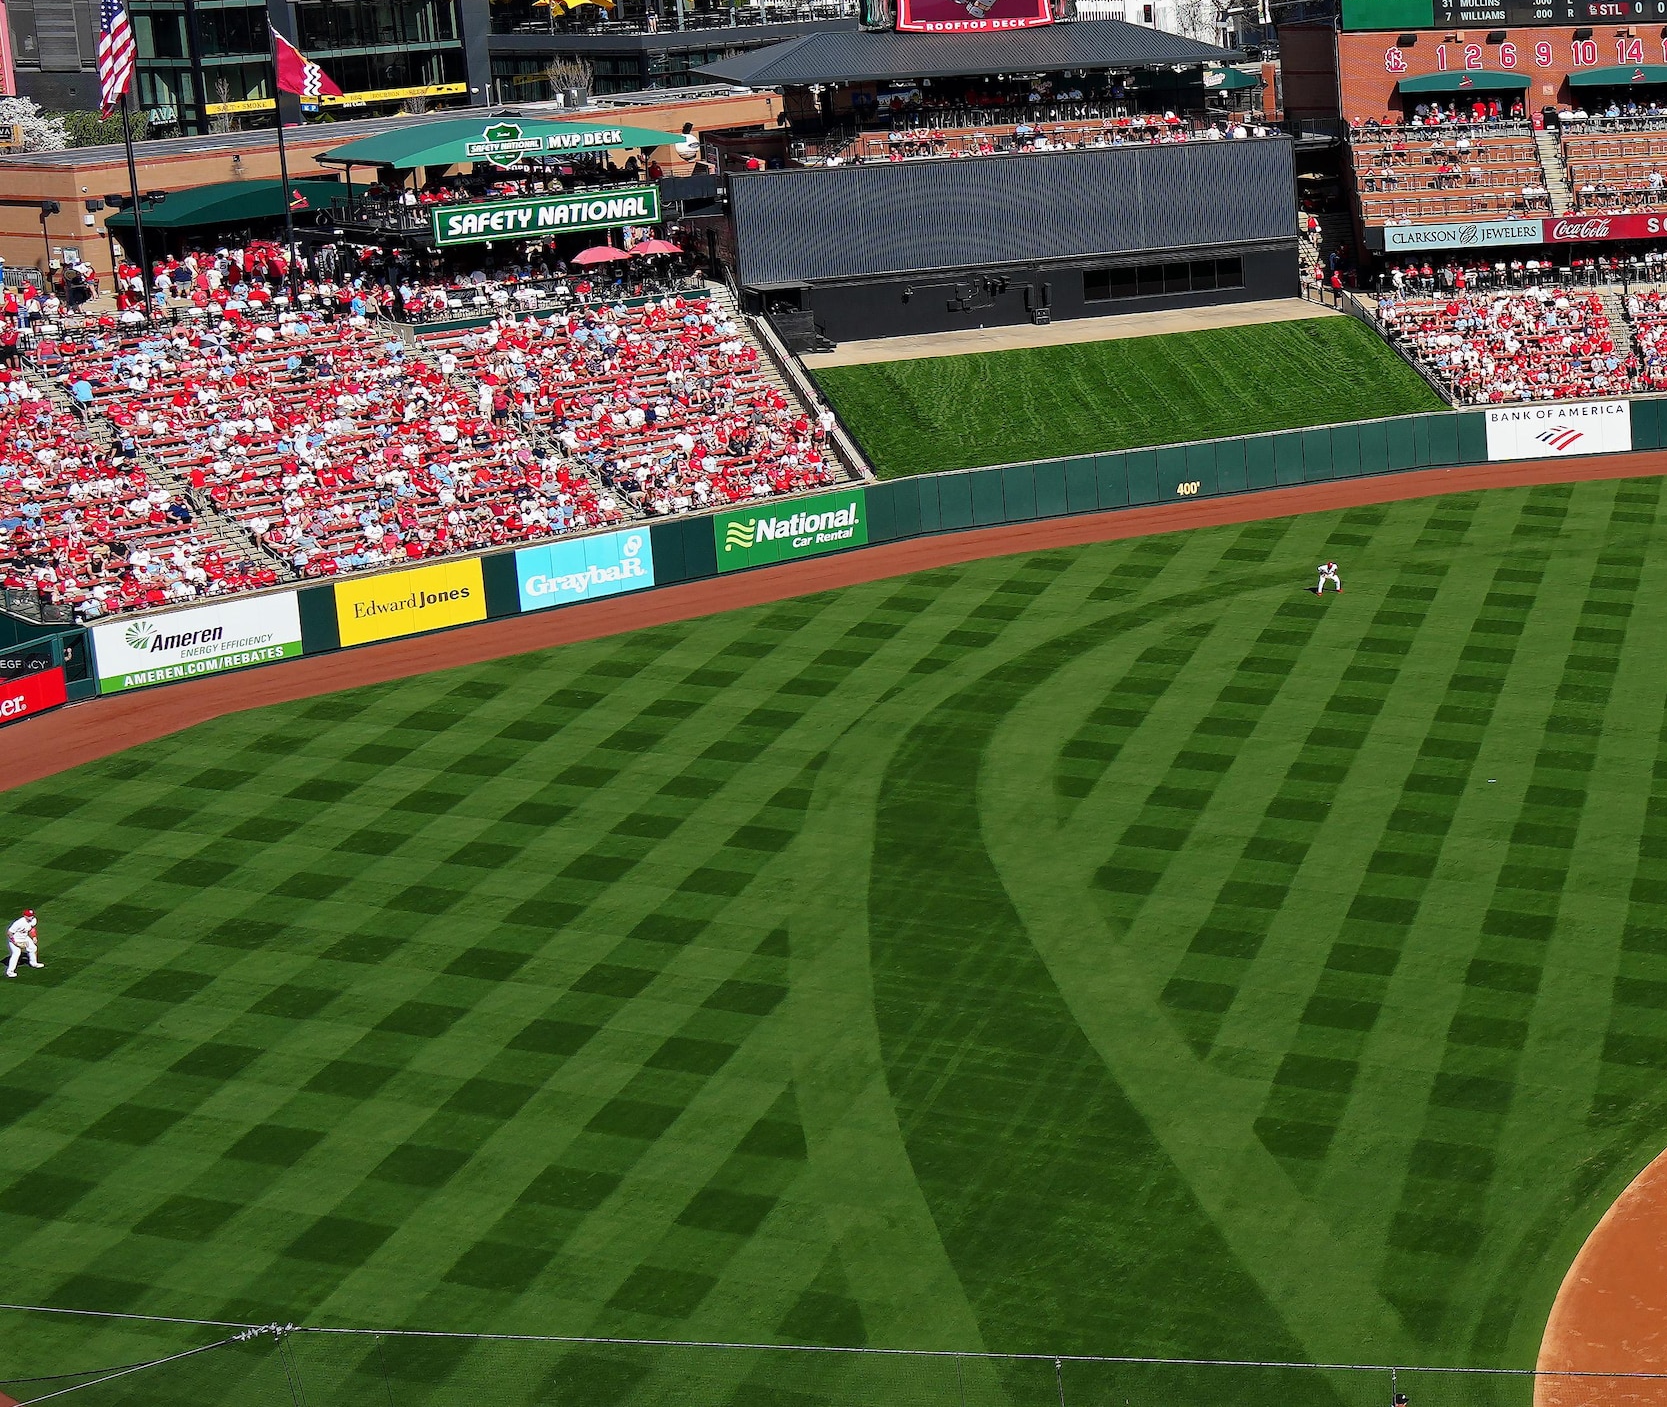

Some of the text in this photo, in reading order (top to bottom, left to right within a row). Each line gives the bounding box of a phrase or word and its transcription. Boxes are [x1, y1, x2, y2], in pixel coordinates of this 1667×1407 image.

[926, 19, 1025, 32] ROOFTOP DECK
[1461, 11, 1506, 20] WILLIAMS
[548, 130, 623, 149] MVP DECK
[448, 197, 648, 236] SAFETY NATIONAL
[1392, 225, 1537, 245] CLARKSON JEWELERS
[1552, 218, 1611, 240] Coca-Cola
[1492, 405, 1624, 422] BANK OF AMERICA
[791, 528, 854, 549] Car Rental
[353, 584, 470, 620] Edward Jones
[150, 626, 222, 652] Ameren
[180, 633, 274, 658] ENERGY EFFICIENCY
[124, 646, 284, 687] AMEREN.COM/REBATES
